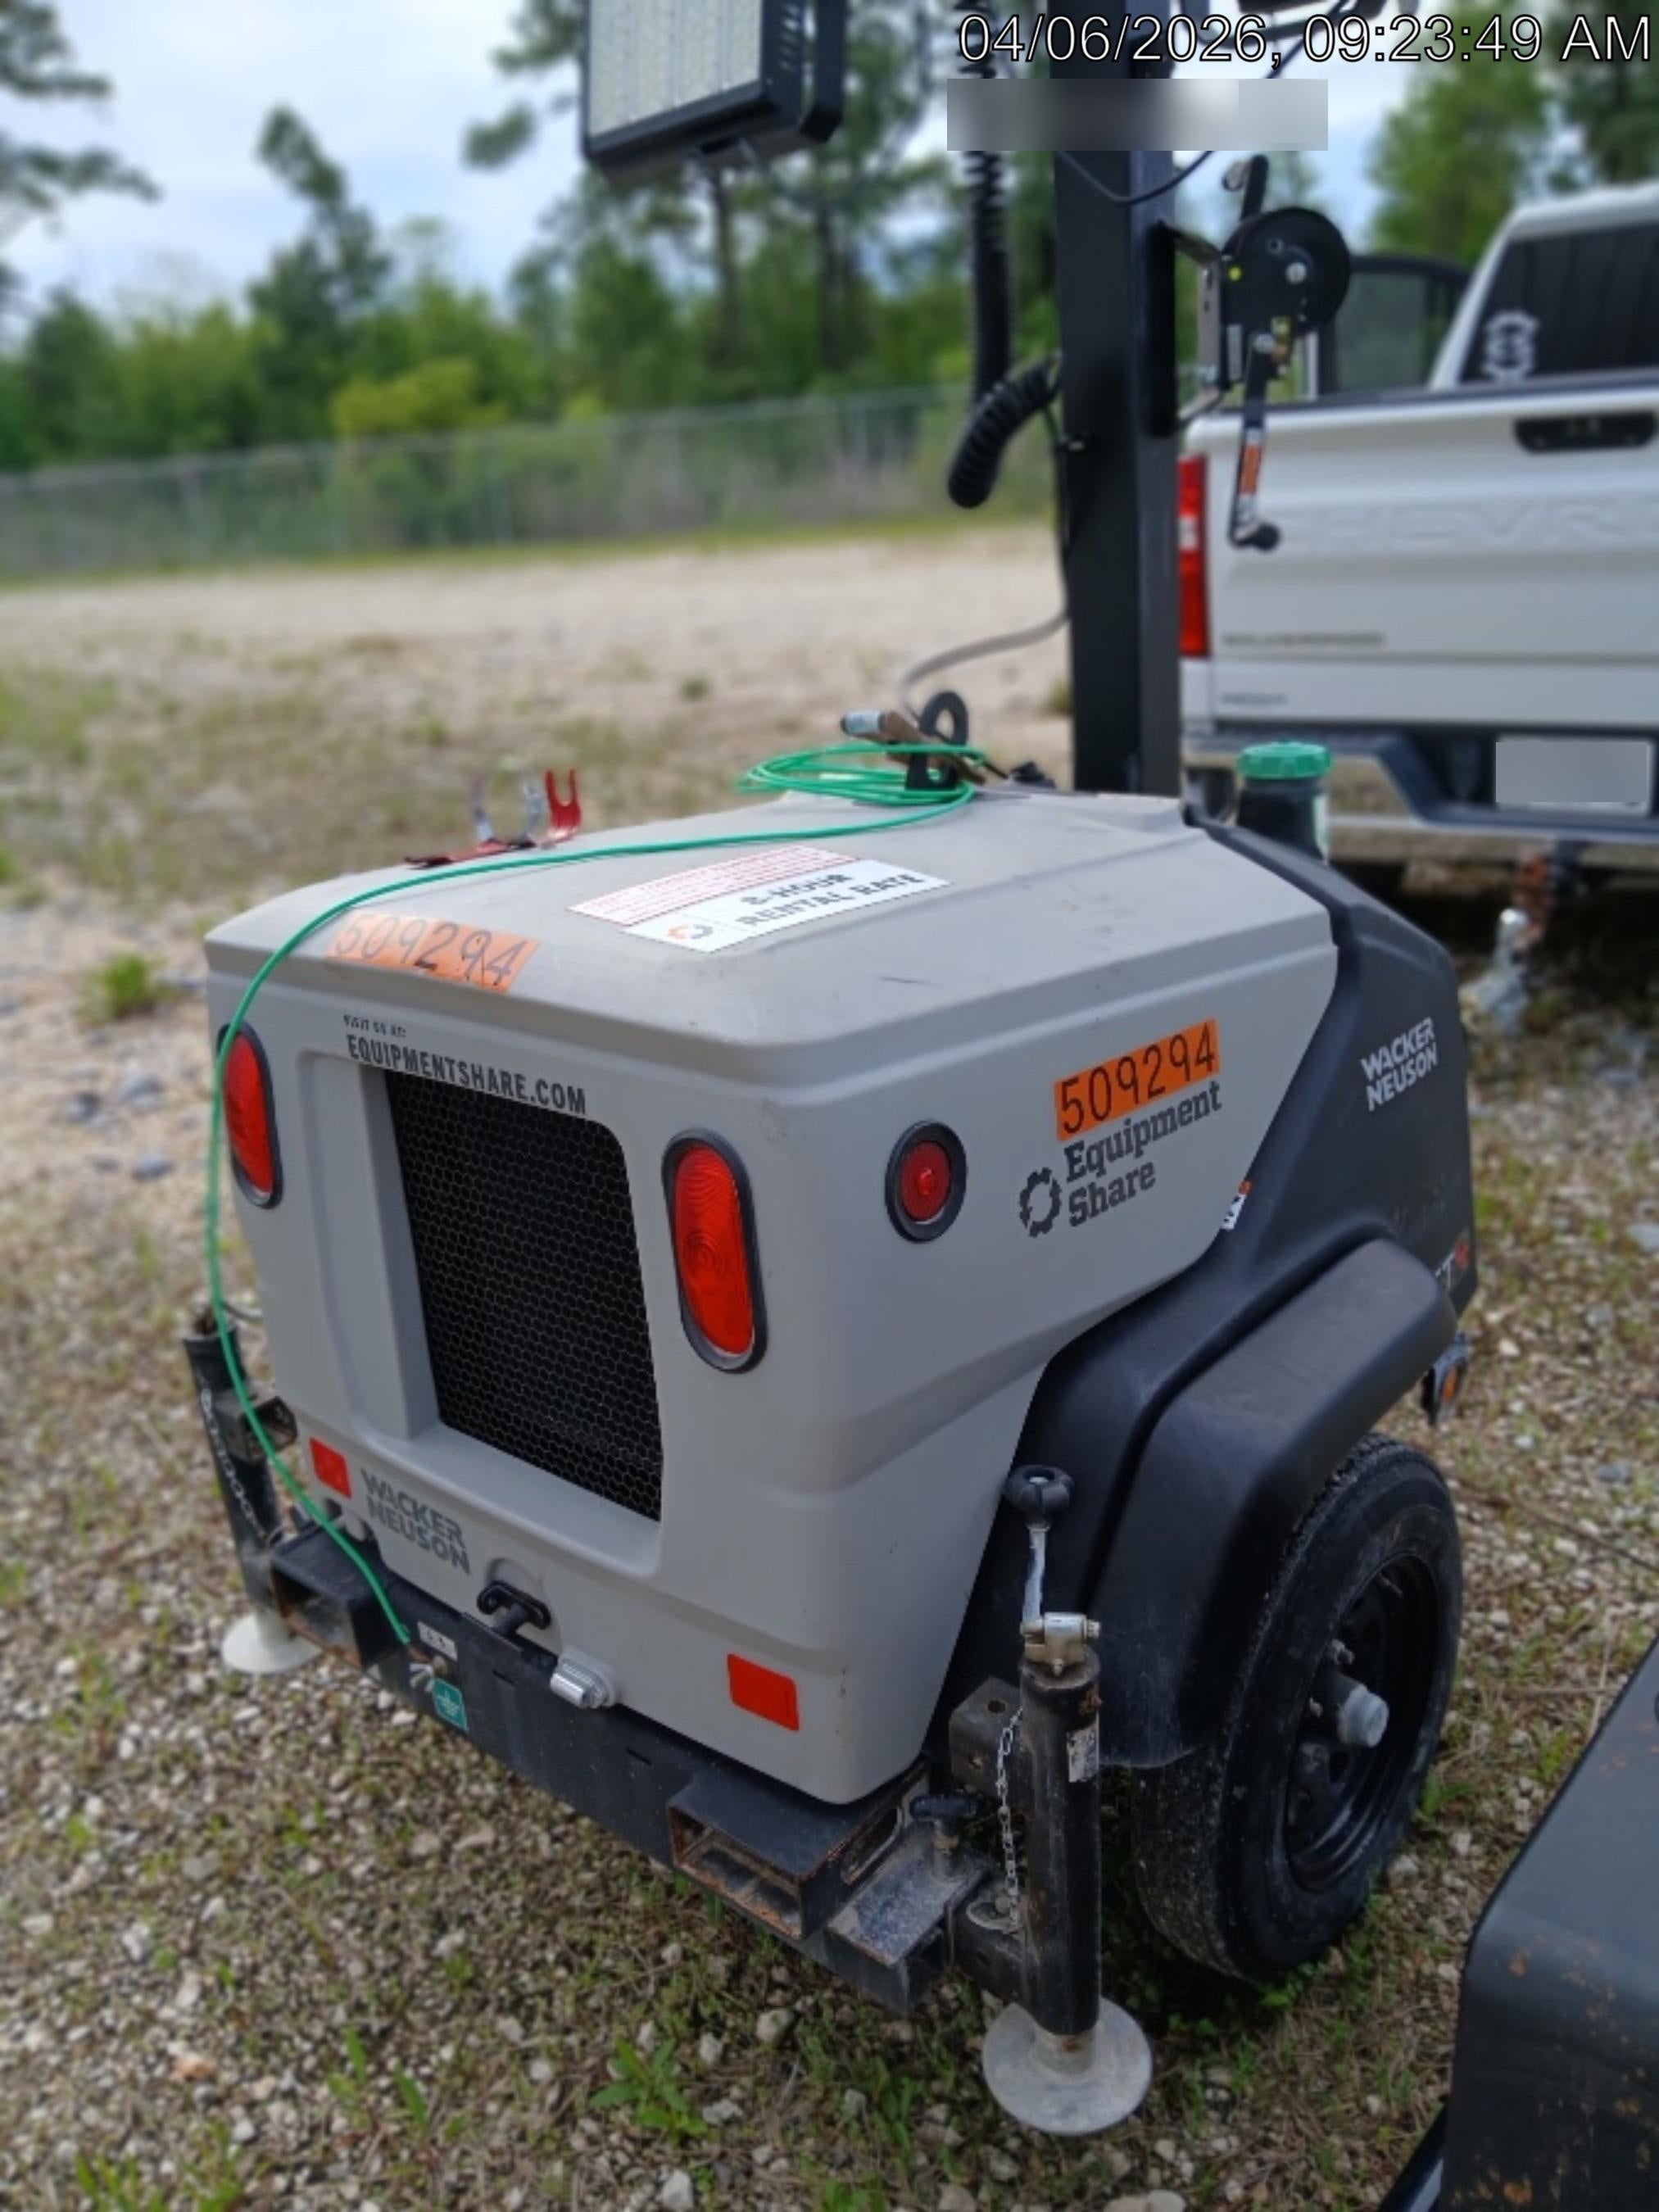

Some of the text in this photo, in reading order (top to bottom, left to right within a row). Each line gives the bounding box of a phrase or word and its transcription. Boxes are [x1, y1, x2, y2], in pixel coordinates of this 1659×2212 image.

[736, 873, 925, 927] RENTAL RATE
[333, 913, 528, 987] 509294
[345, 1034, 587, 1114] EQUIPMENTSHARE.COM
[1060, 1018, 1217, 1135] 509294
[1360, 1016, 1435, 1080] WACKER
[1366, 1040, 1438, 1113] NEUSON
[1064, 1080, 1223, 1183] Equipment
[1068, 1159, 1157, 1227] Share
[361, 1467, 466, 1548] WACKER
[365, 1495, 471, 1575] NEUSON
